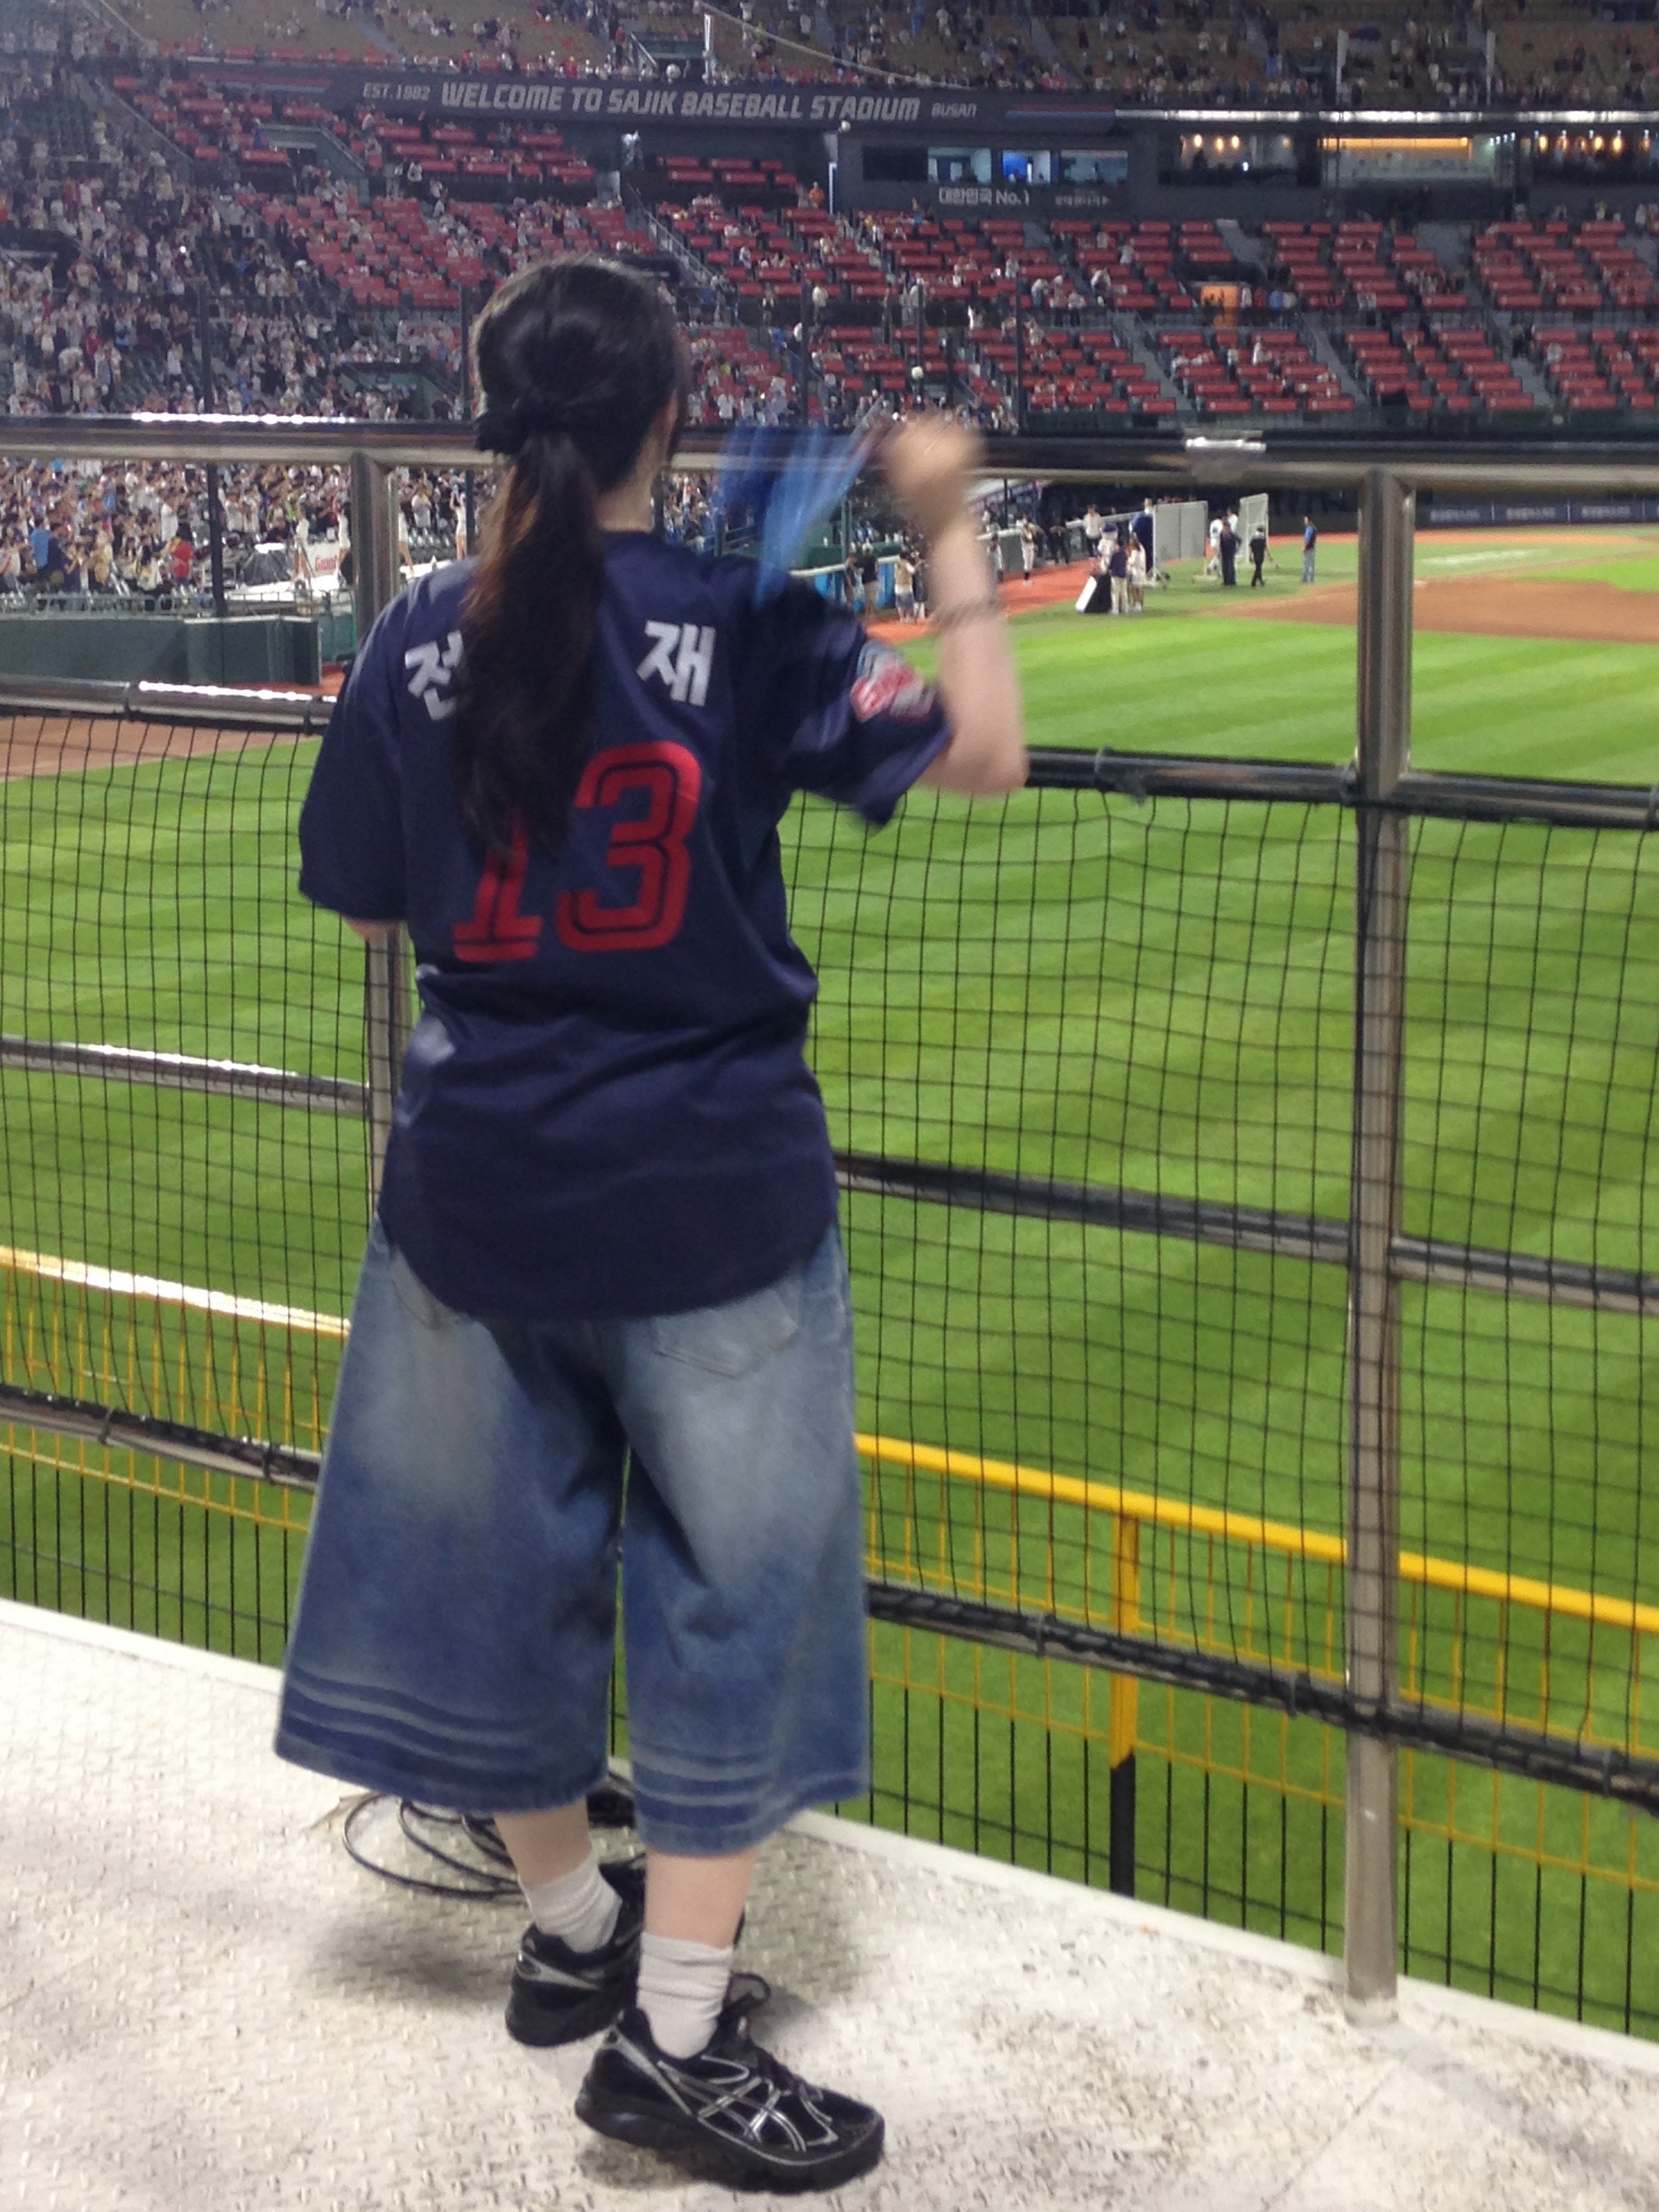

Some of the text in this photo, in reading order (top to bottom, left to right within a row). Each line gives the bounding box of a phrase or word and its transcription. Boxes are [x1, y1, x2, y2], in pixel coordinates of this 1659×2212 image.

[441, 82, 566, 111] WELCOME
[571, 86, 602, 113] TO
[606, 89, 677, 116] SAJIK
[681, 90, 803, 119] BASEBALL
[809, 95, 920, 121] STADIUM
[931, 103, 977, 118] BUSAN
[452, 741, 702, 963] 13
